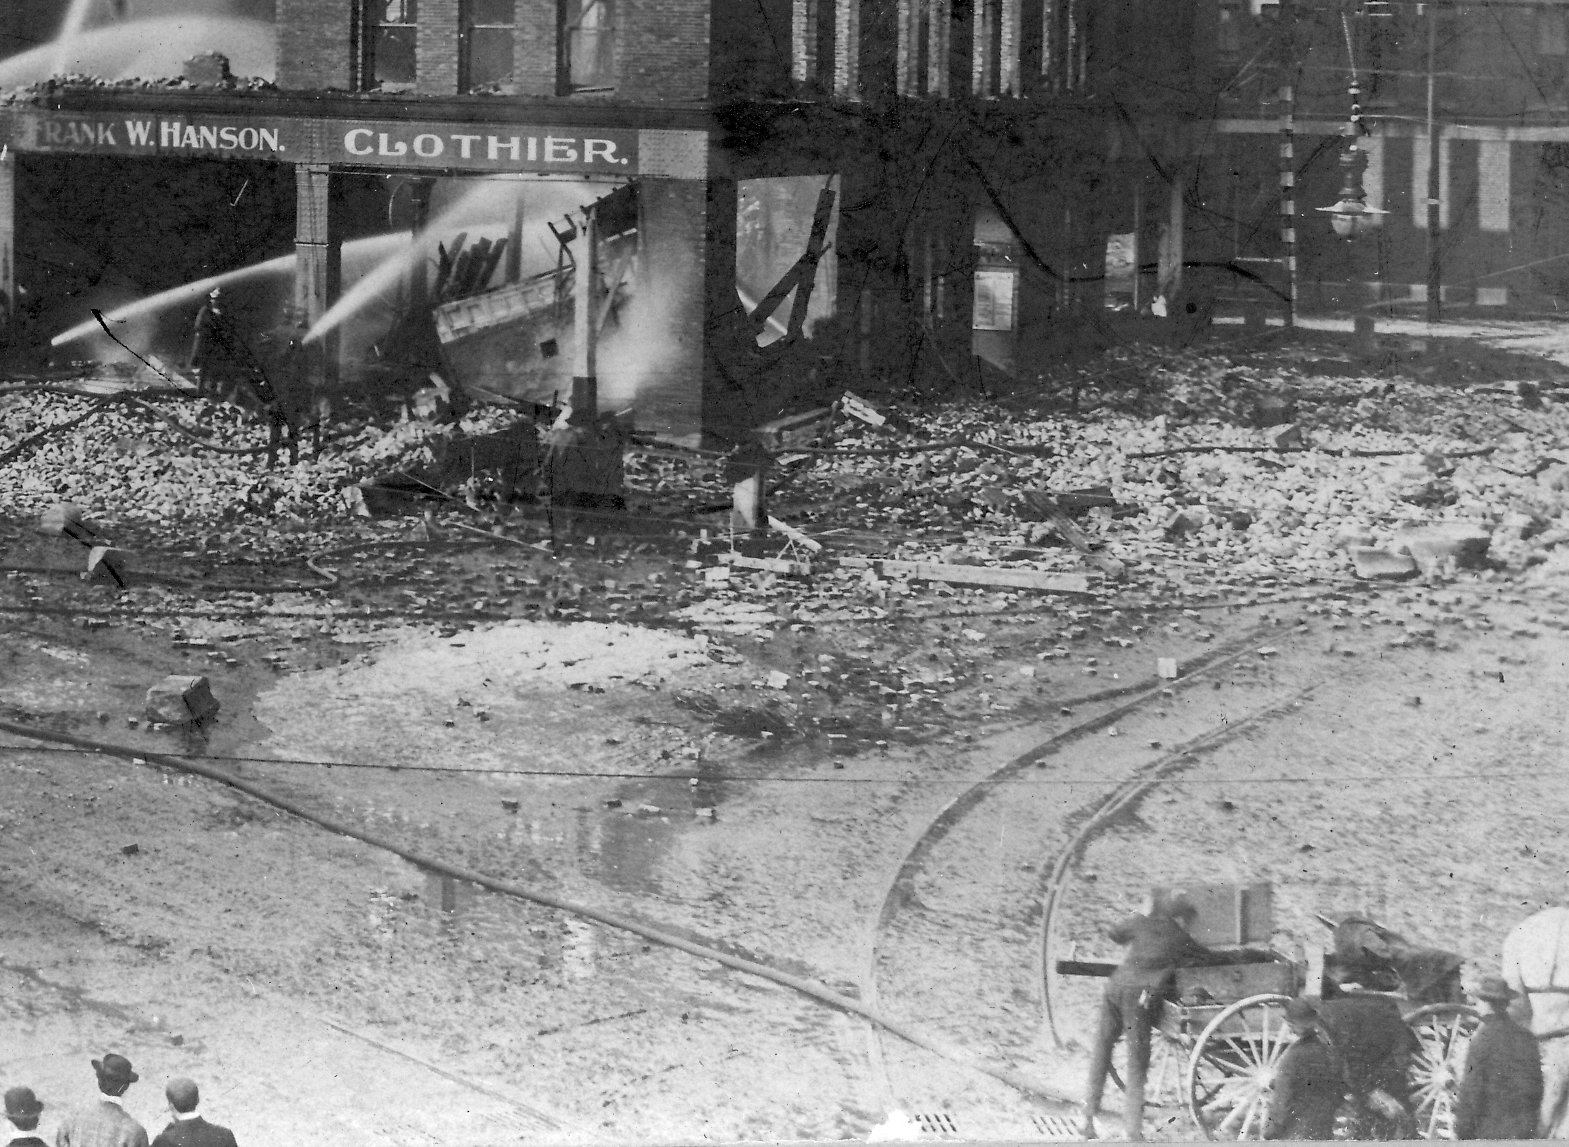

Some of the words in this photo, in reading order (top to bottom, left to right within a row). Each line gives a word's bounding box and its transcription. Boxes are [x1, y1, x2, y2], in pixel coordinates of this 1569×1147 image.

[125, 120, 155, 146] W.
[160, 121, 286, 152] HANSON.
[343, 128, 629, 165] CLOTHIER.
